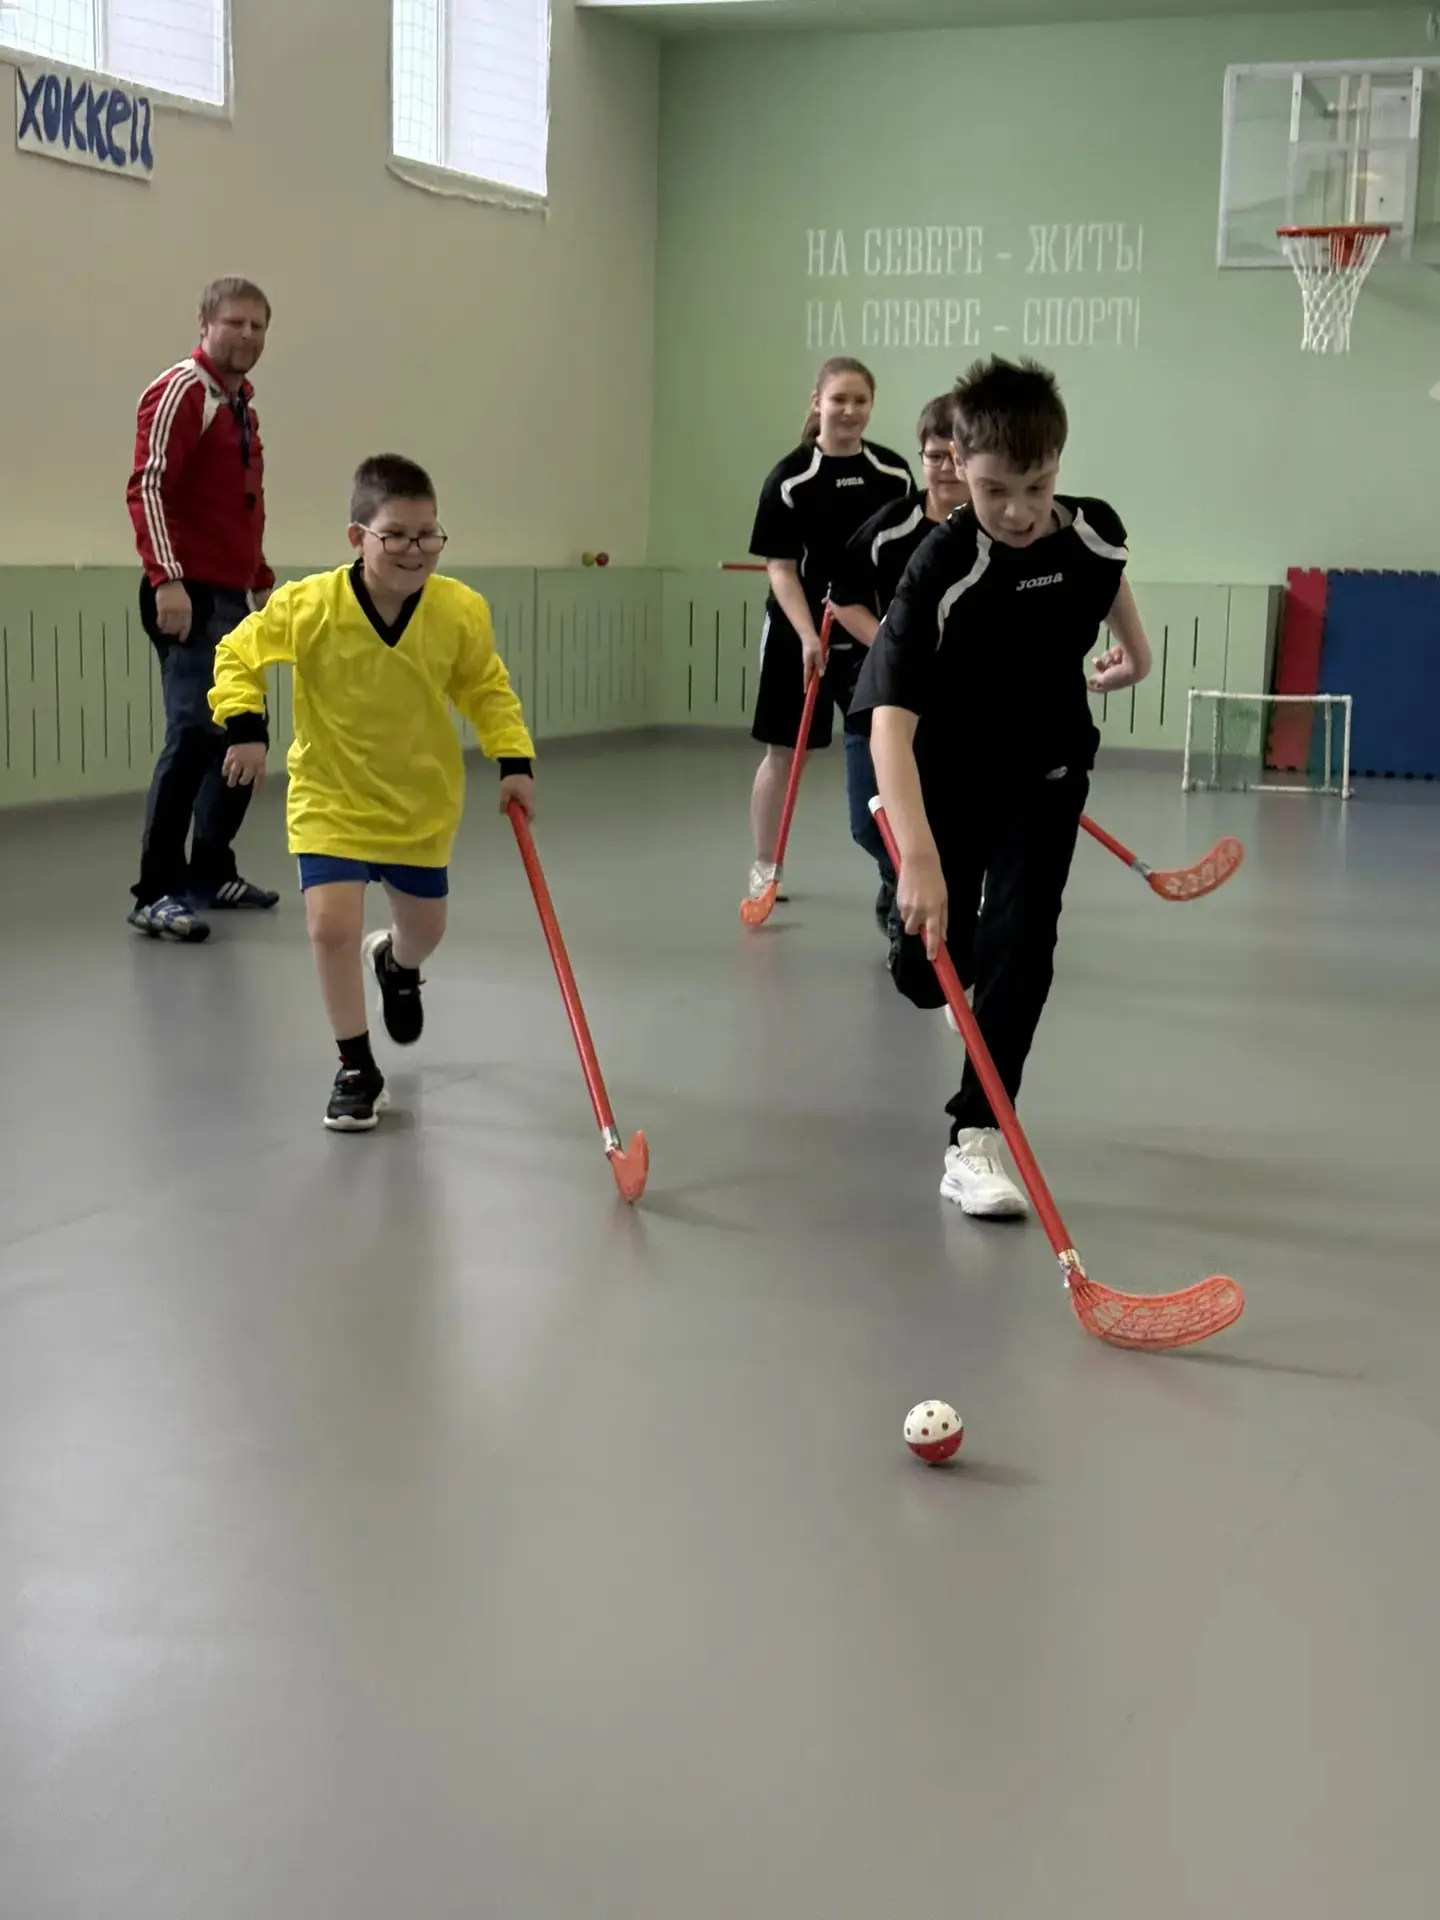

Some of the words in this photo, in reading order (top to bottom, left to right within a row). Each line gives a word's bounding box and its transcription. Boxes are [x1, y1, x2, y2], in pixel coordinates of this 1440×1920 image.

[805, 229, 848, 276] НА
[863, 225, 983, 276] СЕВЕРЕ
[805, 300, 848, 348] НА
[861, 298, 981, 347] СЕВЕРЕ
